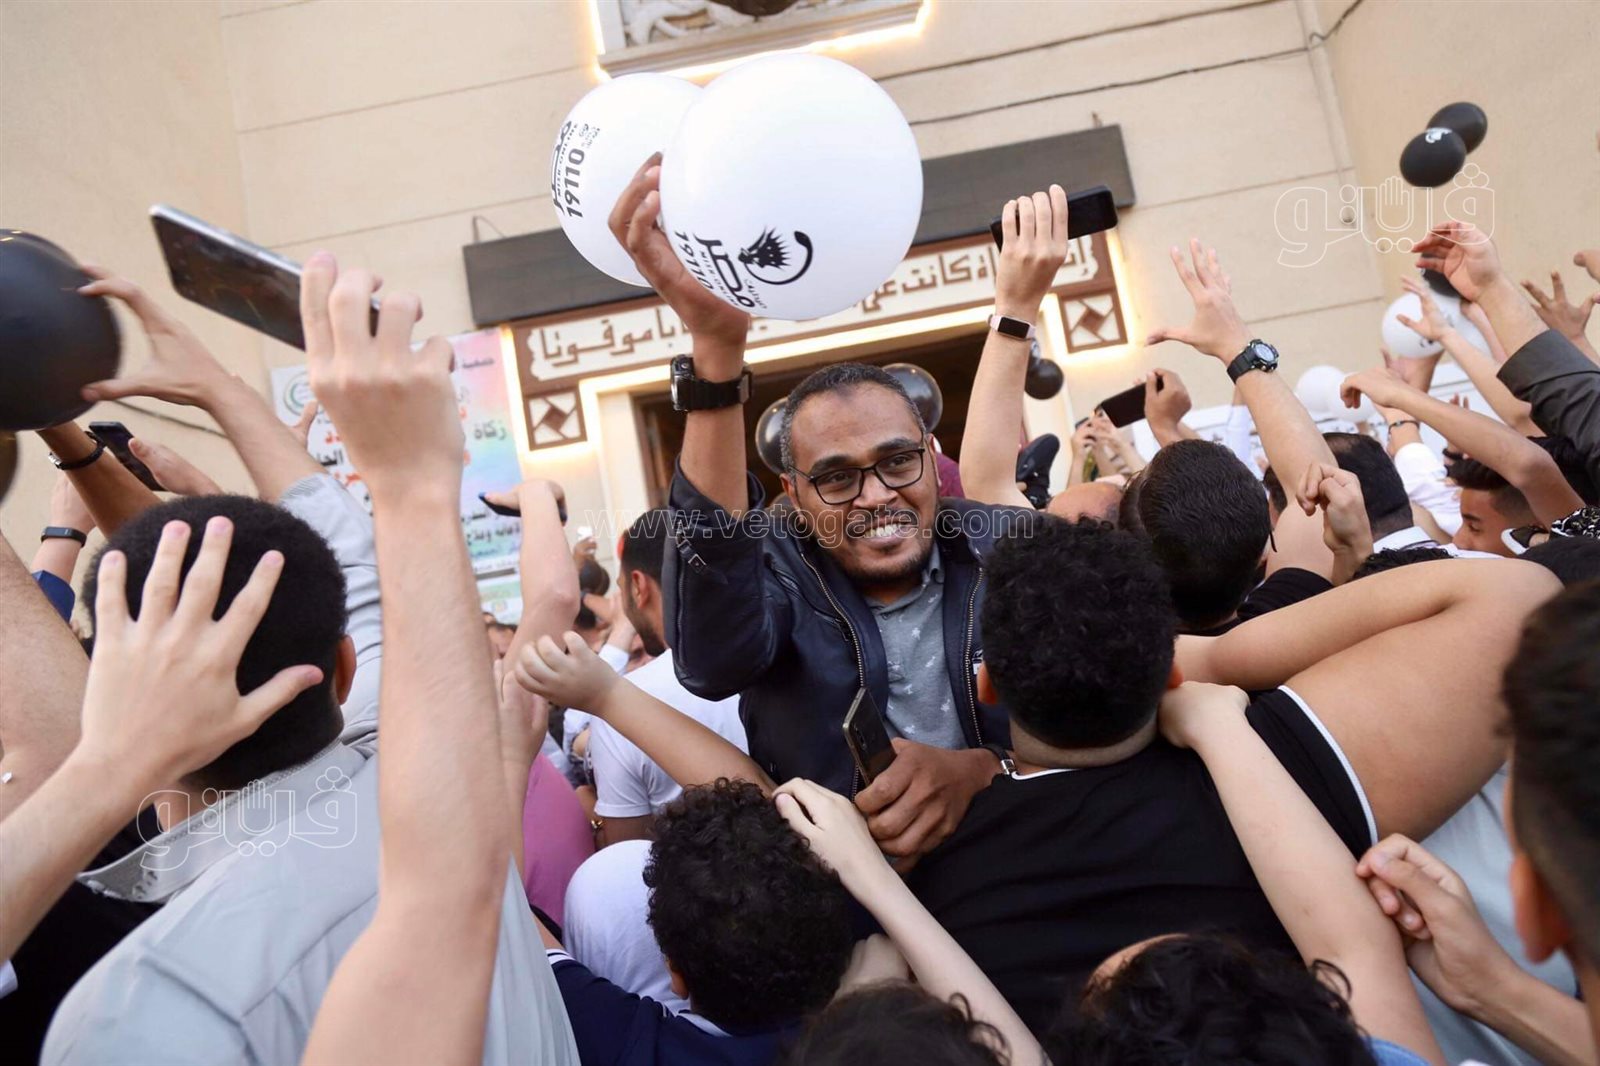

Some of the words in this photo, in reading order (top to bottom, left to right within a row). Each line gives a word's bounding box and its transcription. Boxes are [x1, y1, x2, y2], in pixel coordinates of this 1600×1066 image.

[564, 147, 585, 218] 19110
[674, 230, 715, 290] 19110
[692, 233, 756, 308] مصر
[901, 253, 972, 293] كانت
